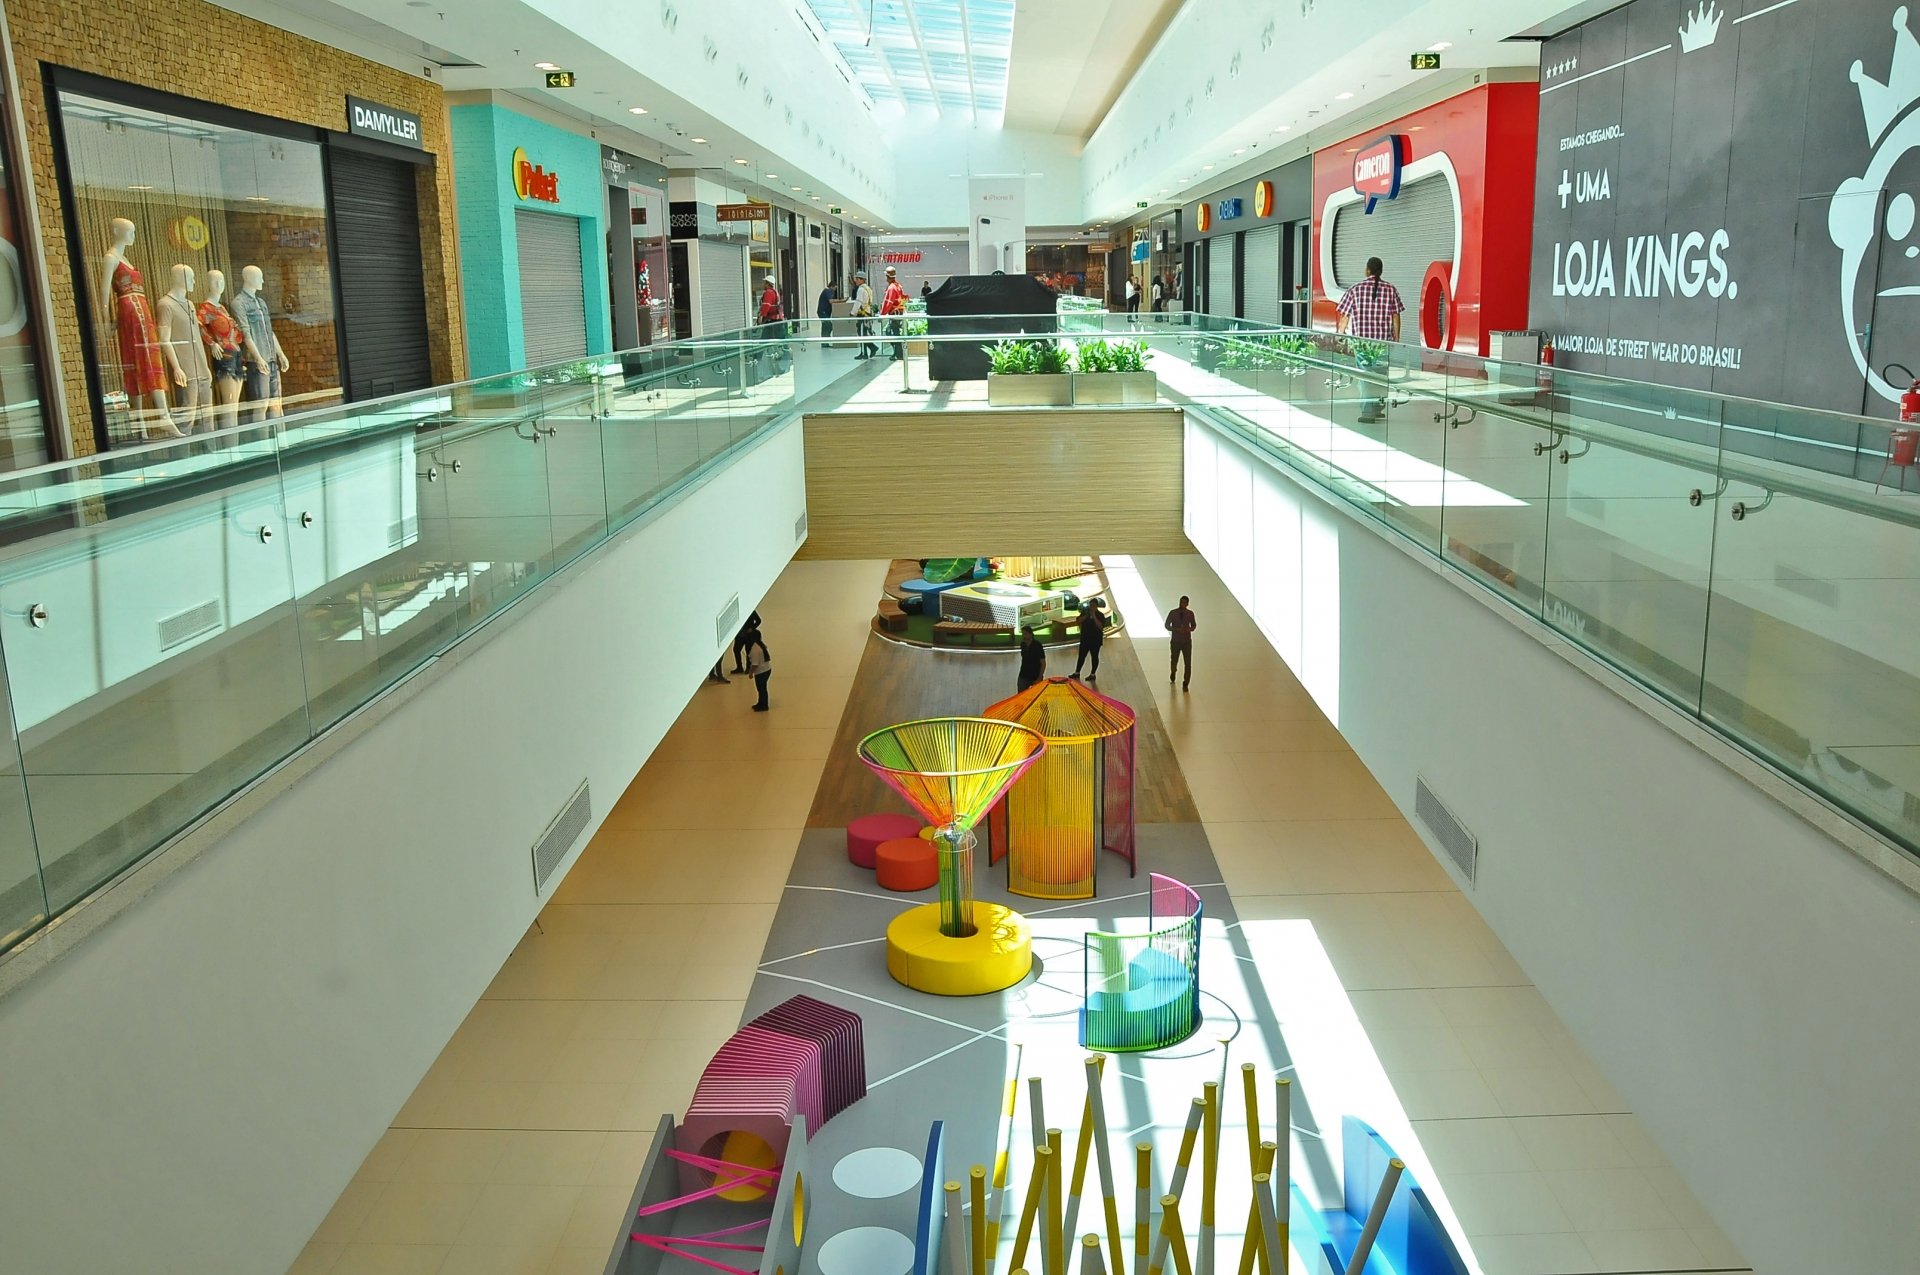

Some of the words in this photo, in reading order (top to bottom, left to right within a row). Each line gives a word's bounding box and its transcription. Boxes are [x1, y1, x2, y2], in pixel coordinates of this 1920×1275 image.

[354, 106, 418, 141] DAMYLLER
[1560, 133, 1586, 152] ESTAMOS
[1585, 124, 1625, 145] CHEGANDO...
[1355, 152, 1391, 182] cameron
[1575, 167, 1611, 204] UMA
[1552, 239, 1616, 298] LOJA
[1623, 228, 1739, 300] KINGS.
[1551, 334, 1557, 350] A
[1558, 335, 1583, 353] MAIOR
[1584, 337, 1604, 355] LOJA
[1605, 338, 1617, 357] DE
[1618, 338, 1650, 360] STREET
[1651, 341, 1680, 364] WEAR
[1681, 344, 1698, 364] DO
[1699, 345, 1742, 370] BRASIL!
